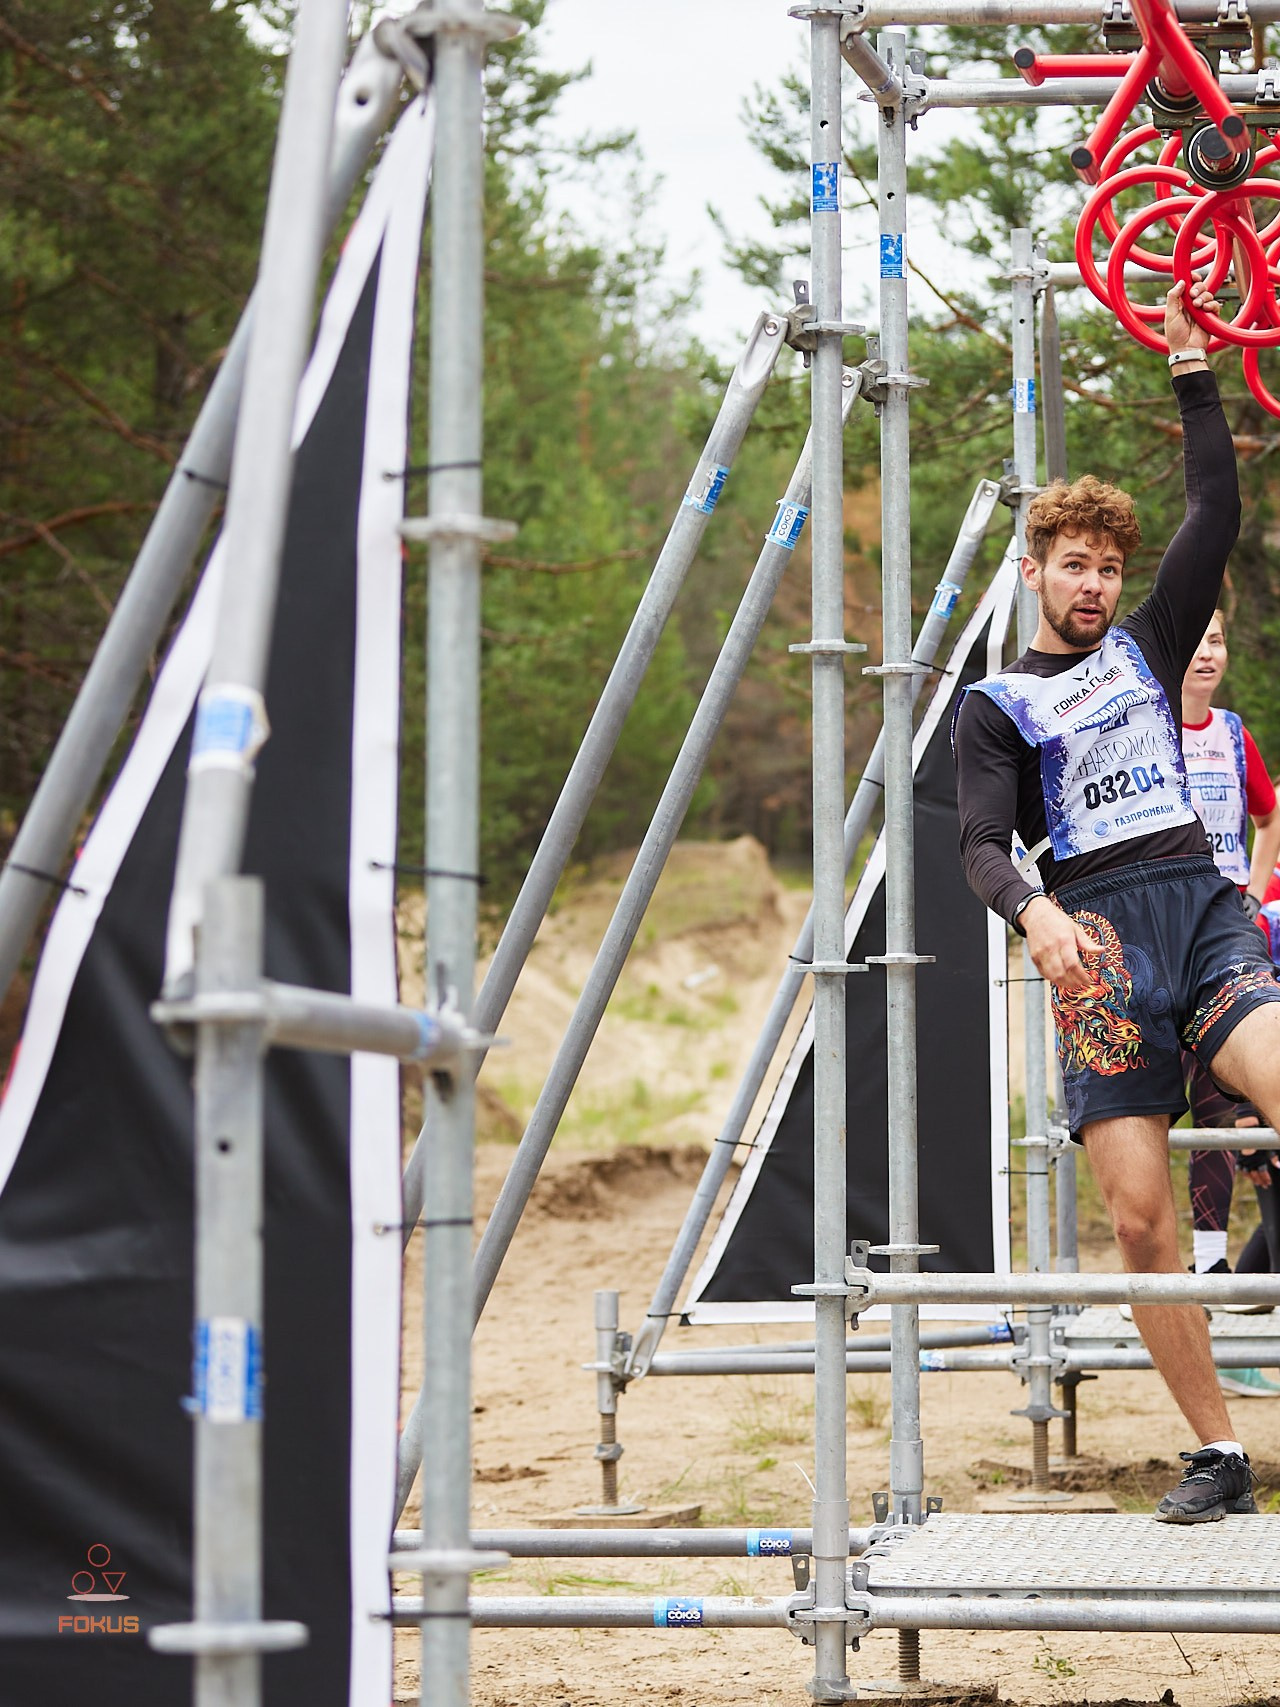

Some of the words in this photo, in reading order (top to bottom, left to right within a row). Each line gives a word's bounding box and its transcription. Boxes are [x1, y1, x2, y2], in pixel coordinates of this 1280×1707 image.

[1053, 687, 1090, 714] ГОНКА
[1083, 762, 1165, 811] 03204
[1201, 787, 1226, 800] СТАРТ
[1114, 804, 1176, 828] ГАЗПРОМБАНК
[1206, 832, 1239, 853] 320
[760, 1538, 790, 1548] СОЮЗ
[667, 1609, 701, 1620] СОЮЗ
